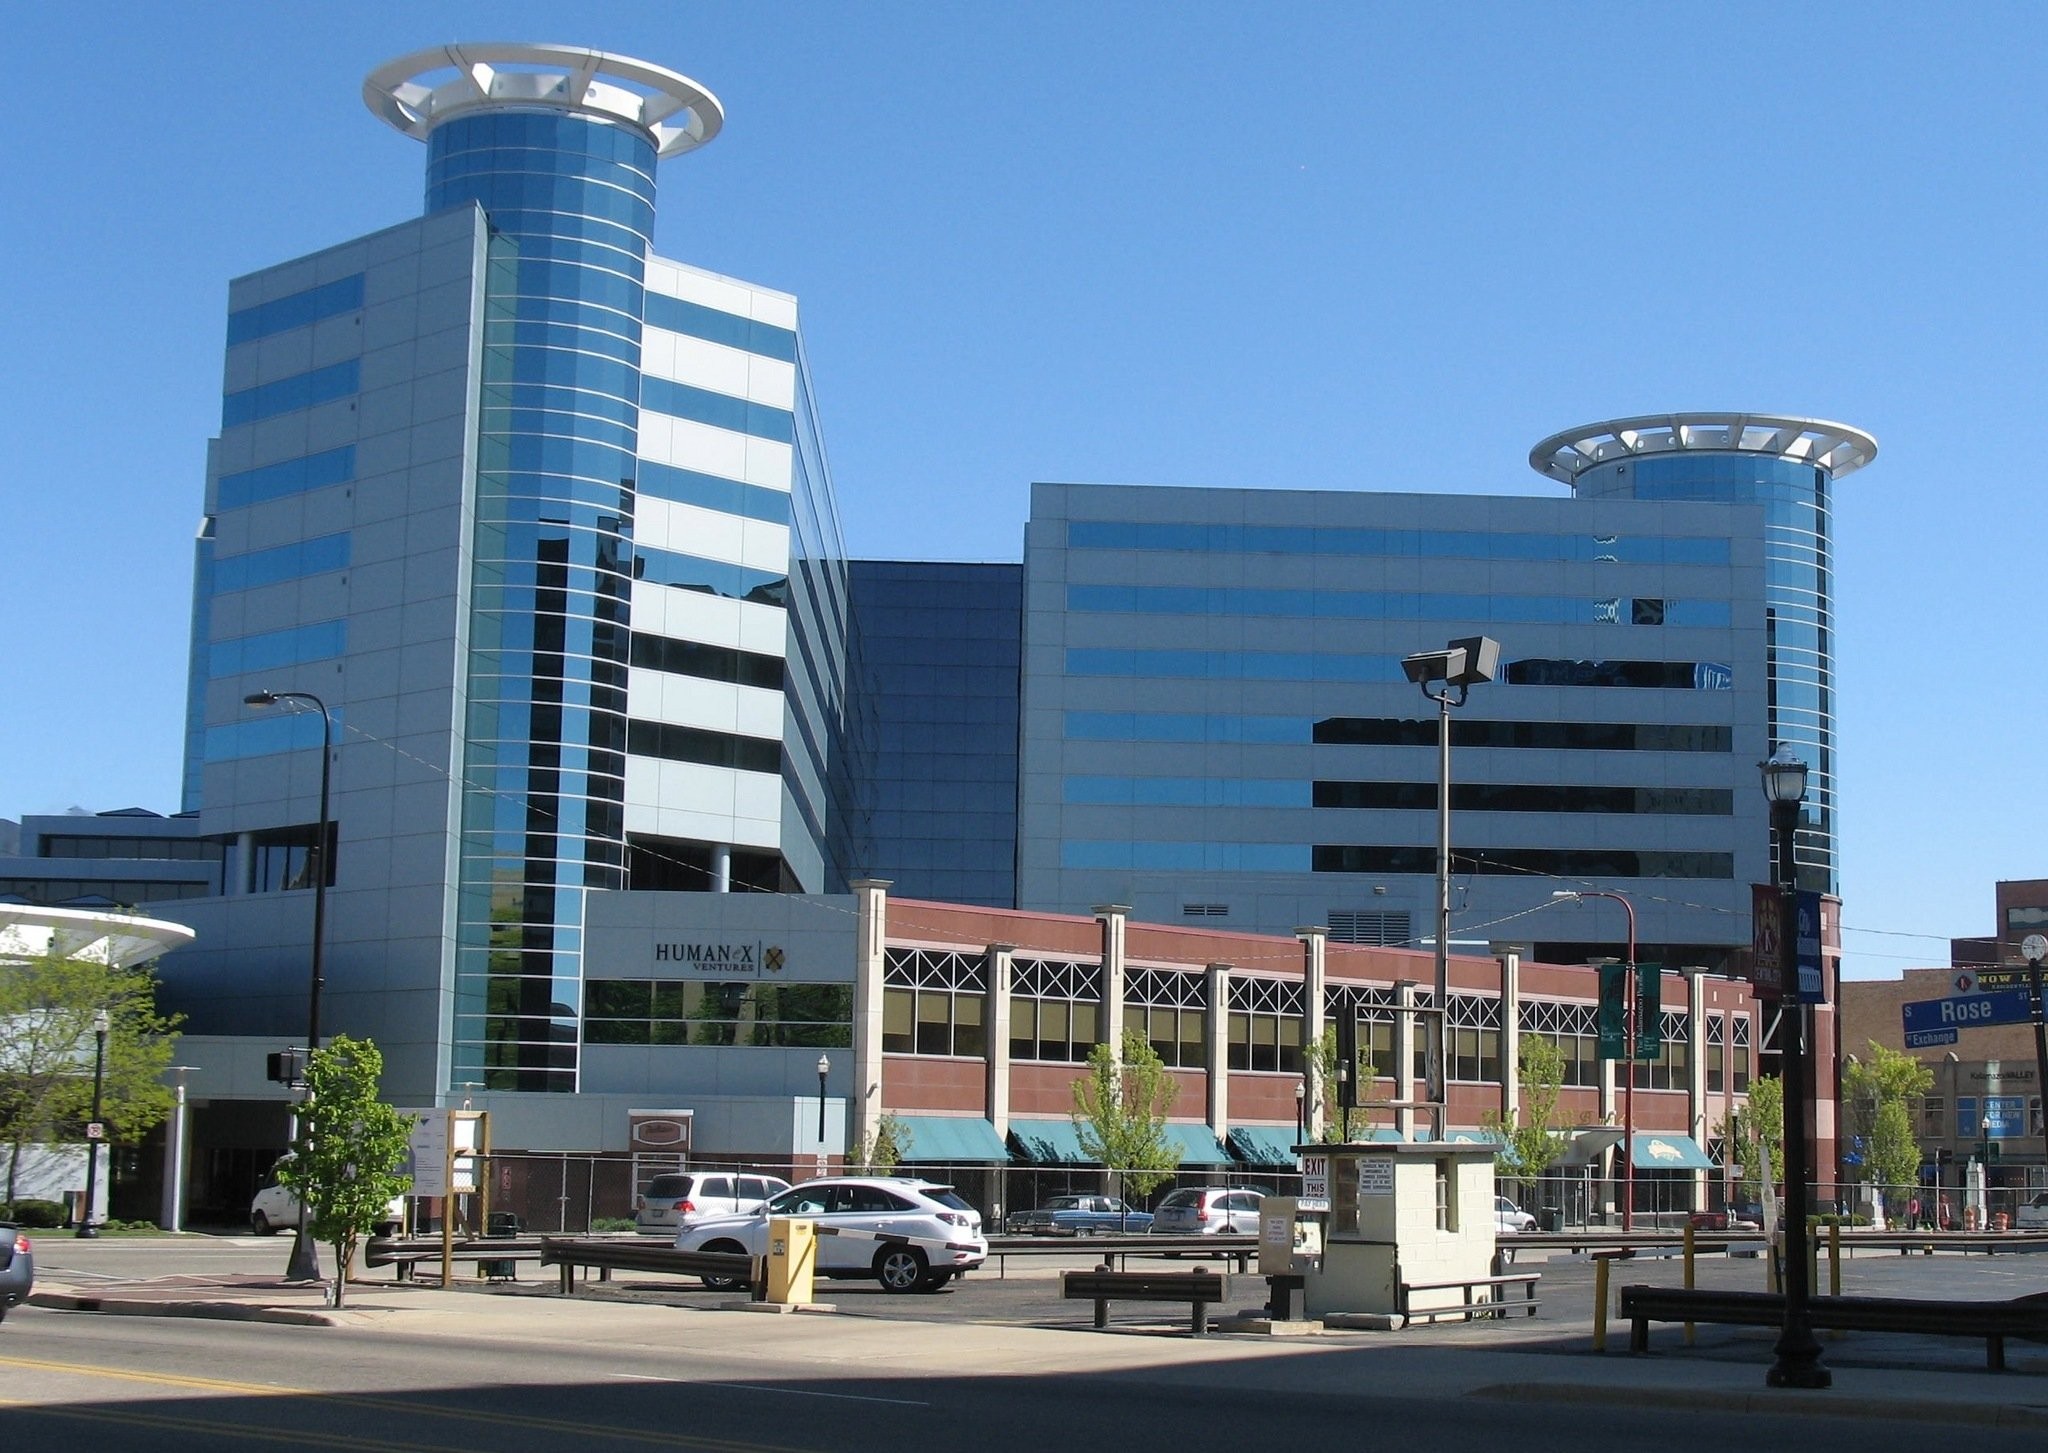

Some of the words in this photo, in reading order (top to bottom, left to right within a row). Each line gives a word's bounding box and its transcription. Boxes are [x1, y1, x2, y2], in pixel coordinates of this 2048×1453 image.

[693, 962, 754, 972] VENTURES
[1978, 975, 2012, 983] NOW
[1904, 1006, 1912, 1017] S
[1940, 1000, 1992, 1022] Rose
[1912, 1031, 1956, 1046] Exchange
[1305, 1158, 1326, 1176] EXIT
[1307, 1183, 1325, 1192] THIS
